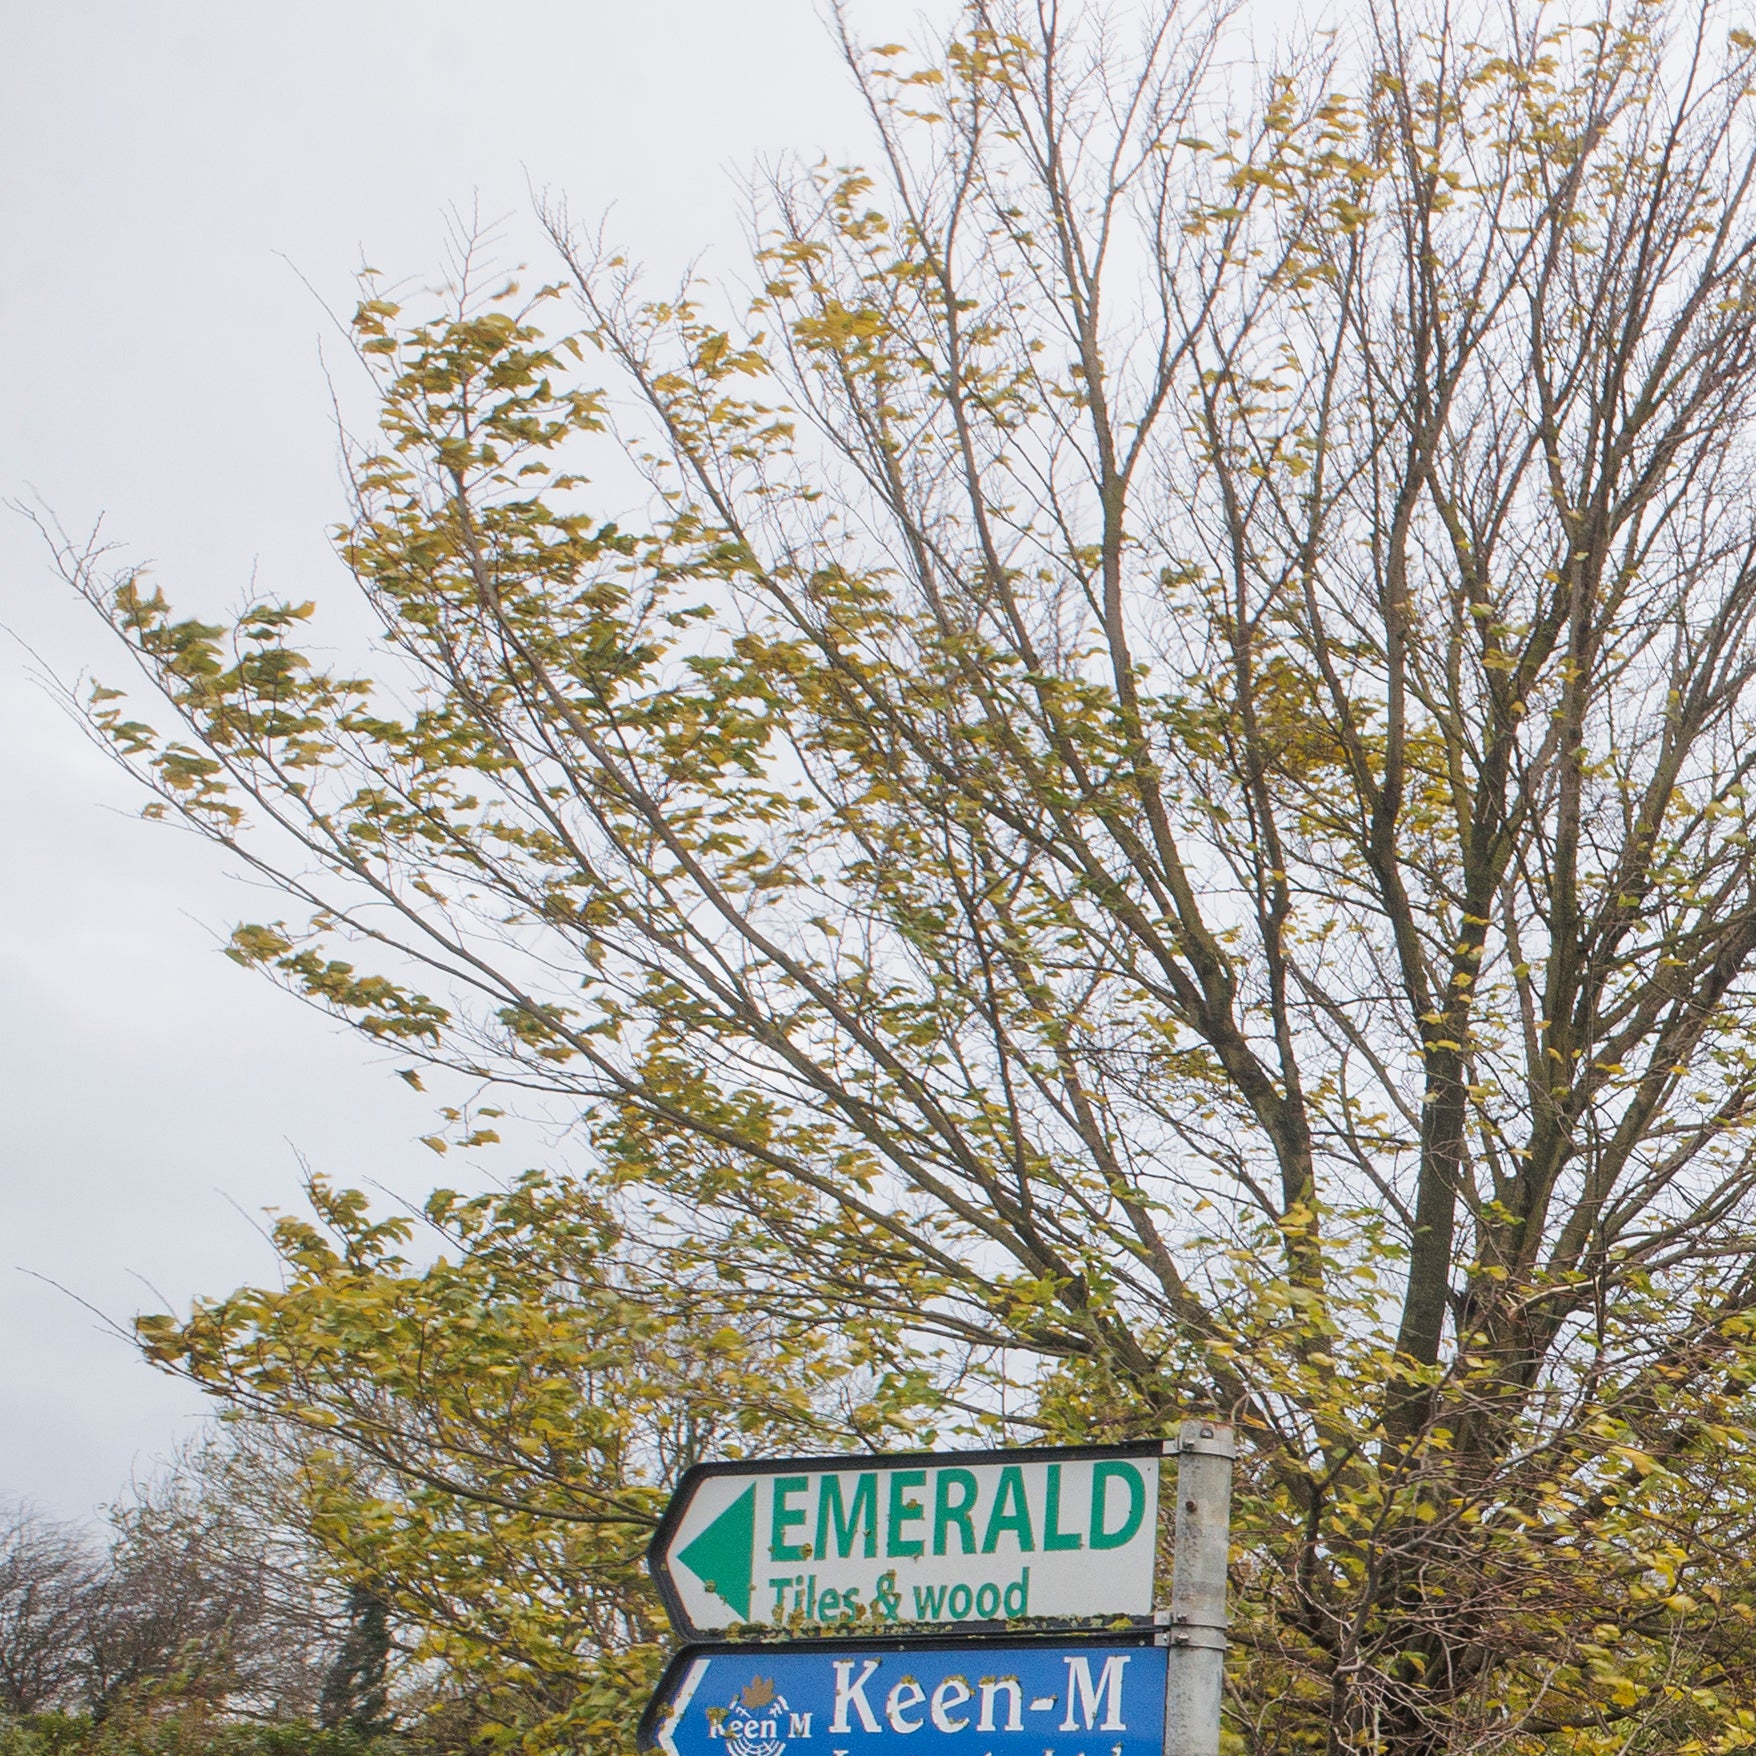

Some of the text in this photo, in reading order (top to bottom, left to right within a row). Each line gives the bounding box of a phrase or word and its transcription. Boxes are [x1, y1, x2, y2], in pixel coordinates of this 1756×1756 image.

[770, 1460, 1146, 1562] EMERALD
[769, 1566, 1031, 1624] Tiles & wood
[787, 1712, 813, 1738] M
[828, 1655, 1131, 1734] Keen-M
